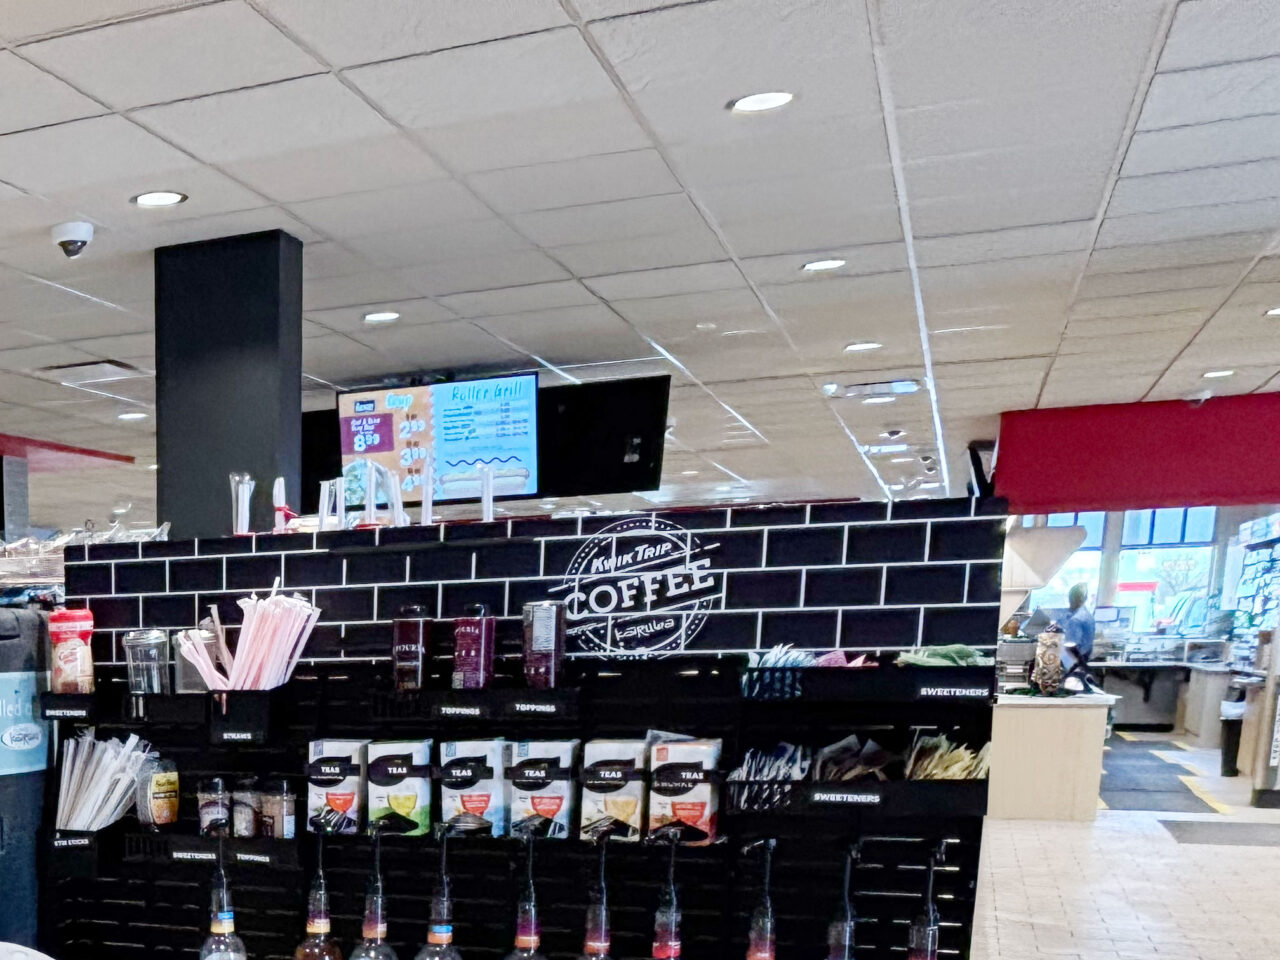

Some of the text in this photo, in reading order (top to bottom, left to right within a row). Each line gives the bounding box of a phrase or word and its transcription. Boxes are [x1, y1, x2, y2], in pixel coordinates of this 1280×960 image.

[634, 542, 673, 561] TRIP
[564, 558, 715, 620] COFFEE
[920, 687, 989, 697] SWEETENERS
[321, 766, 340, 774] TEAS
[387, 766, 407, 774] TEAS
[451, 769, 472, 777] TEAS
[599, 770, 622, 778] TEAS
[680, 771, 704, 779] TEAS
[814, 792, 880, 803] SWEETENERS
